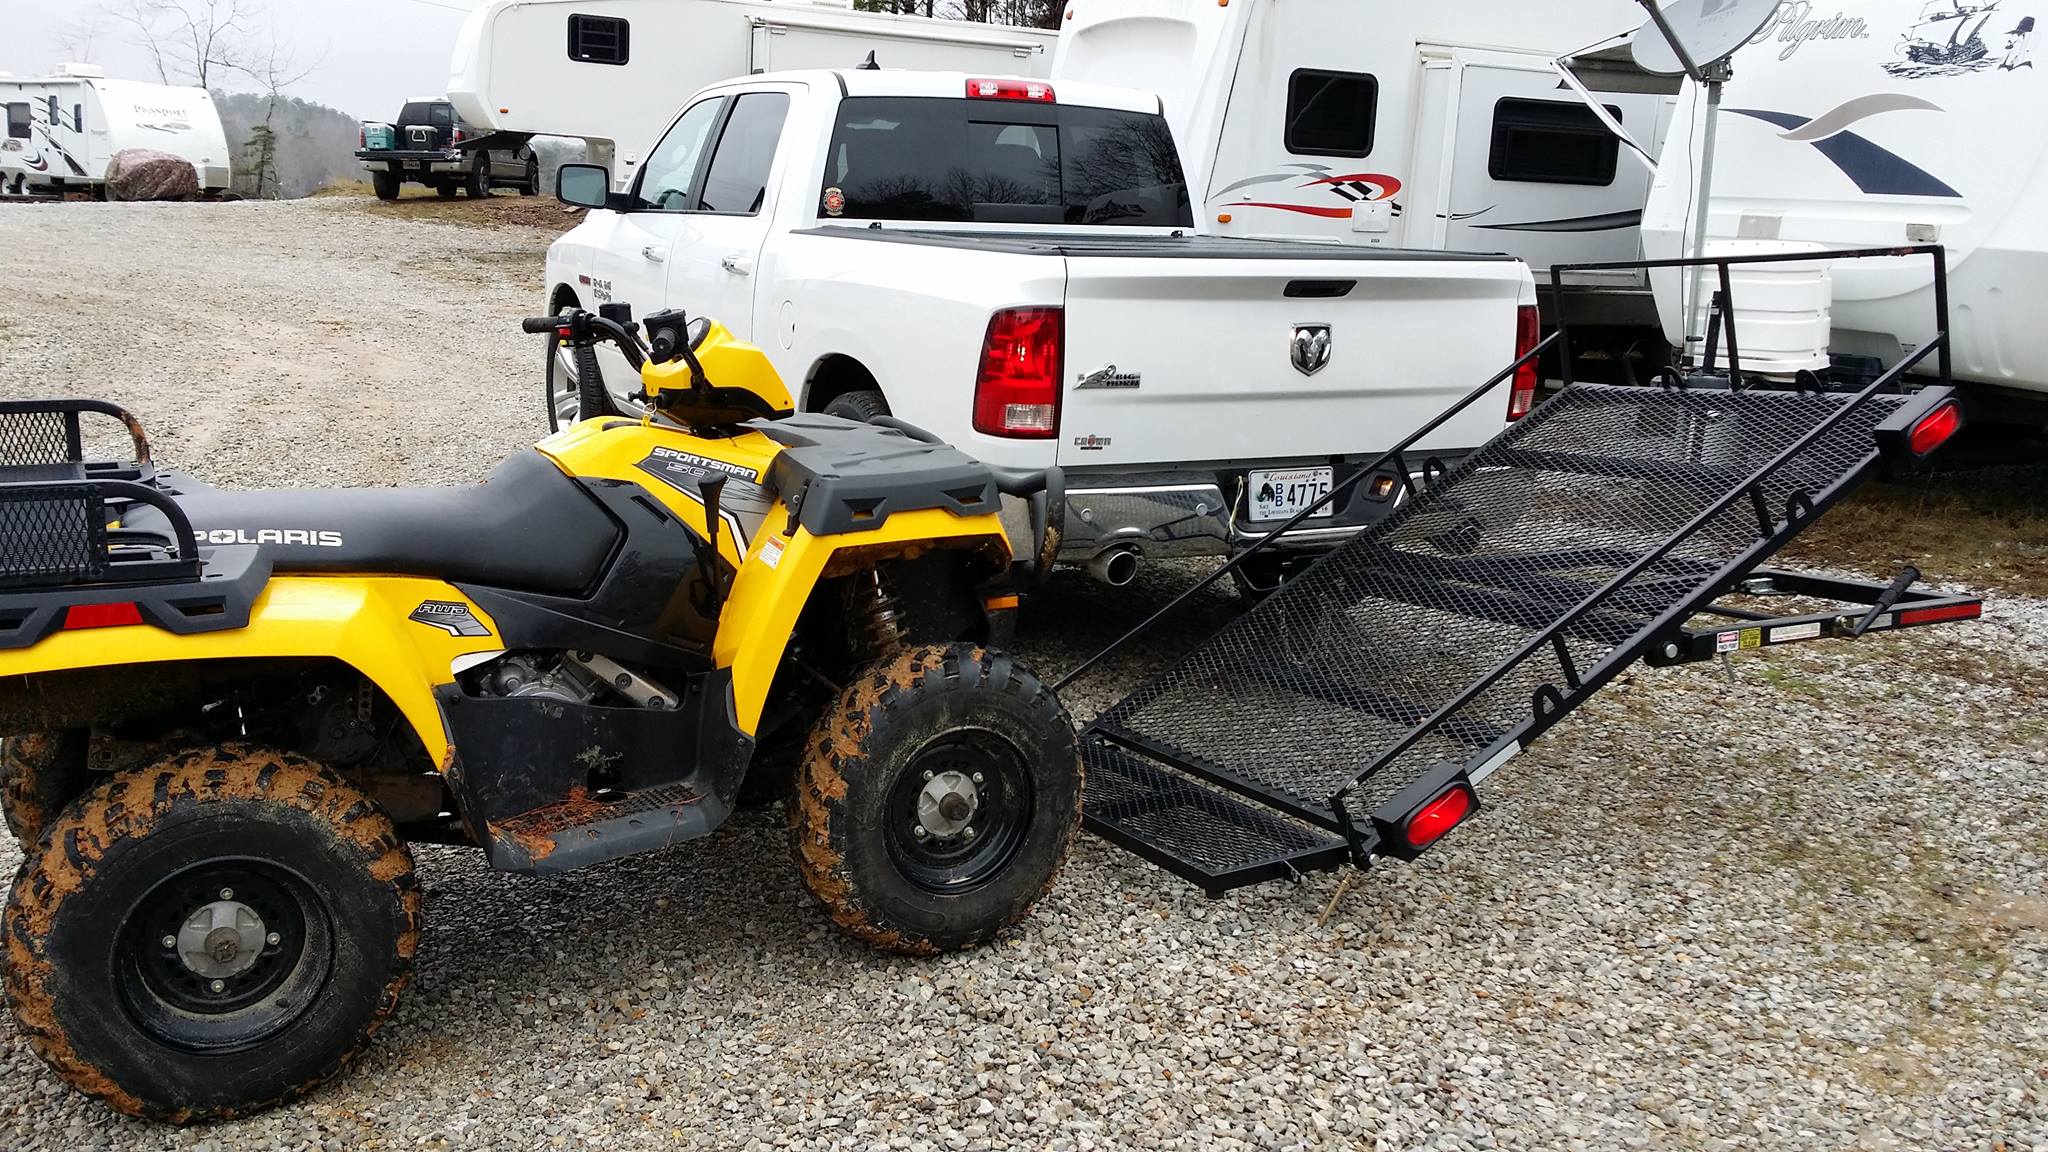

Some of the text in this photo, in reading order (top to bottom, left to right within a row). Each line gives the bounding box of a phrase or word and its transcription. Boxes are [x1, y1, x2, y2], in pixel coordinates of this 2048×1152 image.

[1749, 0, 1868, 61] Pilgrim
[653, 447, 757, 479] SPORTSMAN
[1287, 482, 1328, 506] 4775
[194, 528, 343, 547] POLARIS
[419, 603, 468, 616] AWD
